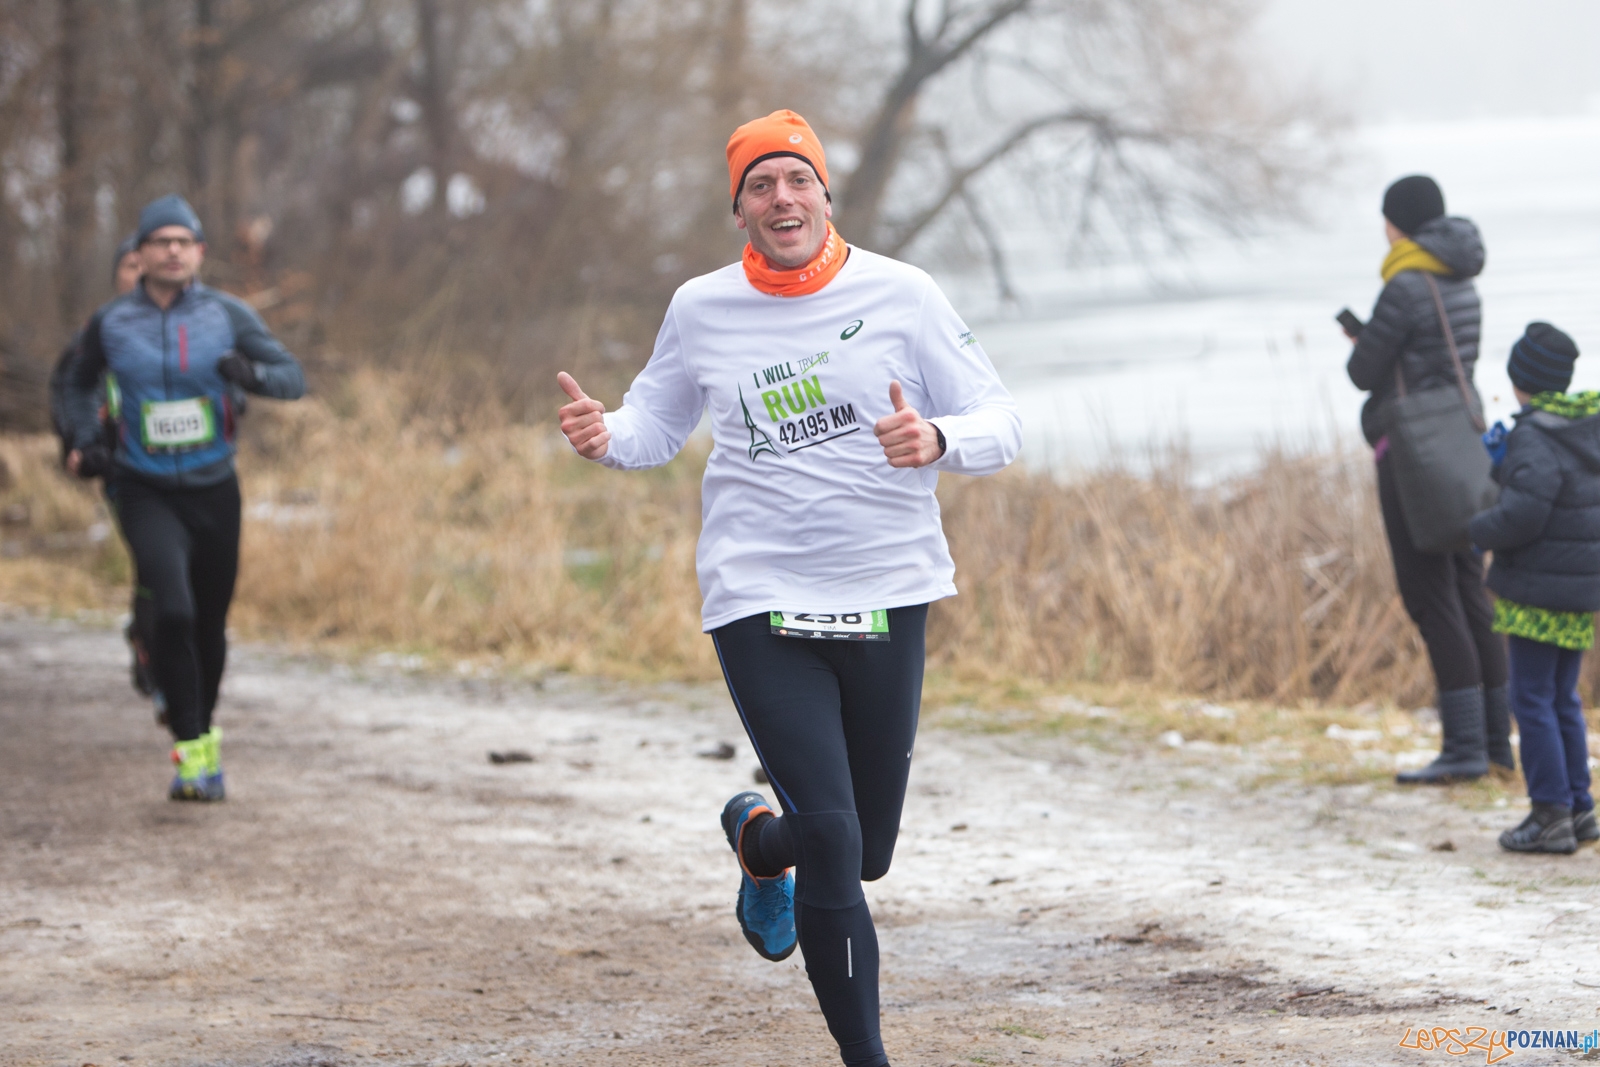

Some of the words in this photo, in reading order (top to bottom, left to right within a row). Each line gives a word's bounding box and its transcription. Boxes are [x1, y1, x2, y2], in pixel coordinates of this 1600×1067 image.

[753, 372, 761, 389] I
[762, 361, 797, 385] WILL
[797, 356, 815, 372] TRY
[816, 351, 830, 366] TO
[761, 374, 827, 423] RUN
[779, 411, 829, 445] 42.195
[829, 403, 857, 429] KM
